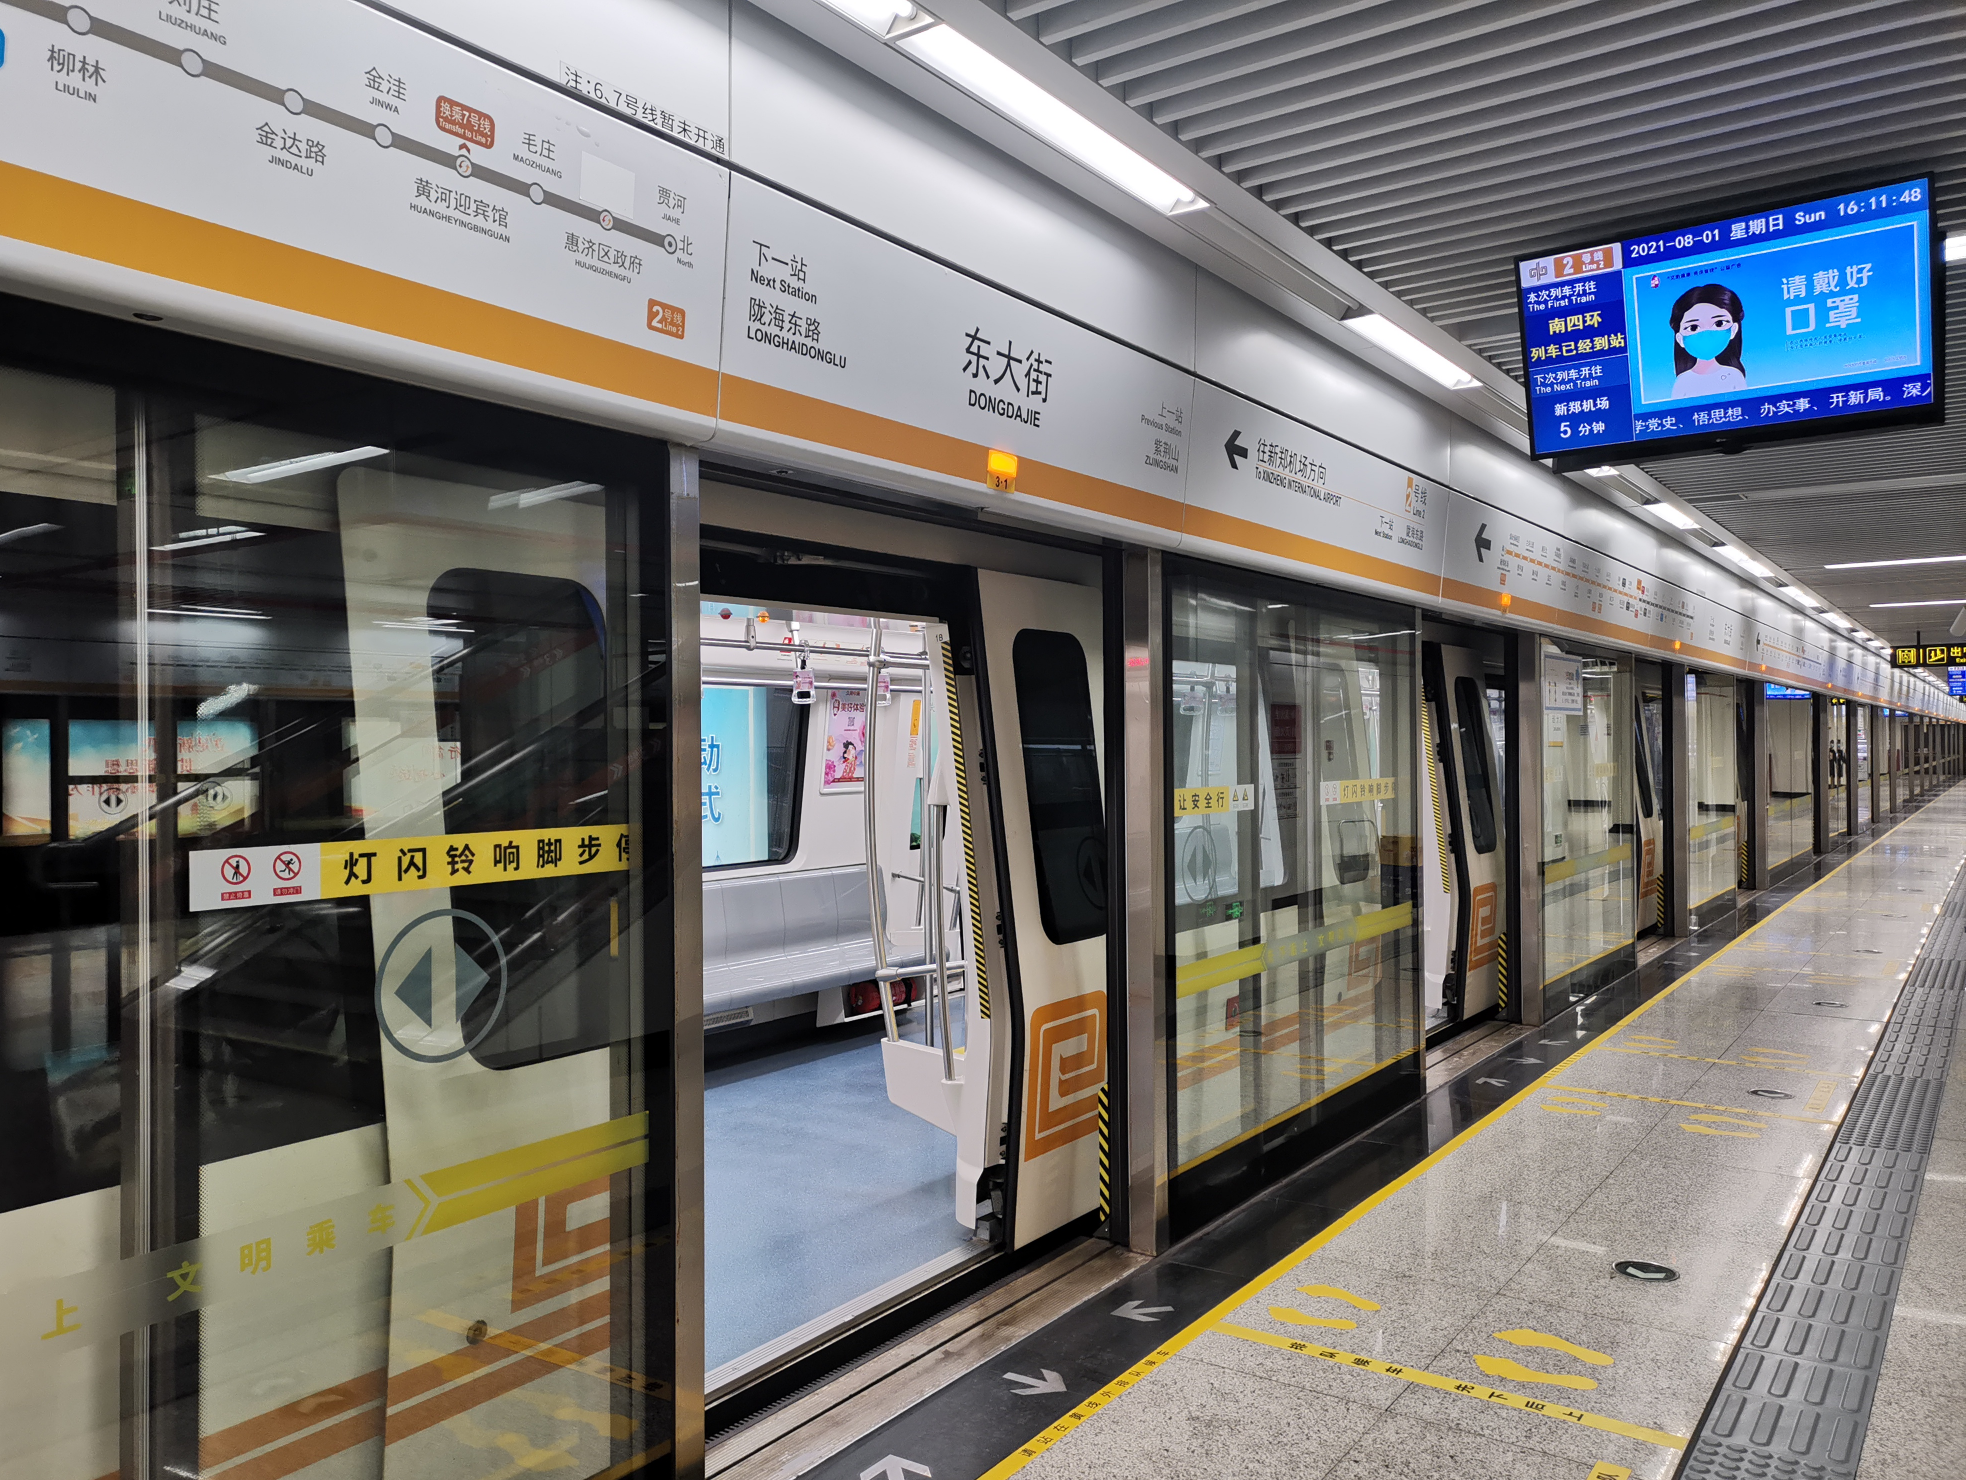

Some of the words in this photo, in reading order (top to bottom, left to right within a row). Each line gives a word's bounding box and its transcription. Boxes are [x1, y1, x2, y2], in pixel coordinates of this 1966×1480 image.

[158, 10, 227, 46] LIUZHUANG
[47, 44, 107, 87] 柳林
[55, 81, 97, 103] LIULIN
[364, 66, 407, 102] 金洼
[369, 96, 400, 116] JINWA
[440, 100, 491, 135] 换乘7号线
[255, 122, 327, 165] 金达路
[439, 118, 465, 135] Transfer
[465, 129, 472, 138] to
[473, 131, 486, 144] Line
[487, 137, 491, 146] 7
[522, 131, 556, 162] 毛庄
[268, 155, 314, 177] JINDALU
[512, 153, 563, 179] MAOZHUANG
[414, 177, 510, 229] 黄河迎宾馆
[657, 185, 687, 215] 贾河
[409, 202, 511, 244] HUANGHEYINGBINGUAN
[661, 213, 682, 227] JIAHE
[1630, 229, 1720, 258] 2021-08-01
[1730, 214, 1784, 241] 星期日
[1795, 210, 1825, 225] Sun
[1837, 188, 1922, 217] 16:11:48
[564, 231, 643, 276] 惠济区政府
[679, 235, 694, 257] 北
[676, 256, 694, 270] North
[752, 239, 808, 284] 下一站
[1582, 264, 1597, 272] Line
[750, 267, 776, 290] Next
[779, 279, 817, 304] Station
[1527, 281, 1597, 303] 本次列车开往
[1781, 263, 1873, 300] 请戴好
[1528, 302, 1545, 312] The
[1548, 298, 1568, 309] First
[1571, 293, 1595, 304] Train
[1784, 294, 1862, 336] 口罩
[662, 321, 677, 332] Line
[678, 326, 683, 335] 2
[748, 296, 821, 344] 陇海东路
[1548, 311, 1602, 336] 南四环
[747, 325, 847, 369] LONGHAIDONGLU
[1530, 332, 1625, 362] 列车已经到站
[962, 326, 1053, 404] 东大街
[1533, 365, 1603, 385] 下次列车开往
[1535, 386, 1551, 395] The
[1554, 382, 1574, 392] Next
[1576, 378, 1599, 389] Train
[968, 388, 1041, 428] DONGDAJIE
[1158, 401, 1183, 425] 上一站
[1554, 396, 1610, 416] 新郑机场
[1141, 414, 1163, 431] Previous
[1165, 423, 1182, 437] Station
[1560, 422, 1572, 438] 5
[1578, 421, 1606, 436] 分钟
[1145, 454, 1179, 474] ZIJINGSHAN
[1153, 438, 1180, 463] 紫荆山
[1257, 437, 1327, 485] 往新郑机场方向
[1255, 466, 1262, 480] To
[1262, 469, 1287, 488] XINZHENG
[1287, 478, 1322, 501] INTERNATIONAL
[1323, 491, 1342, 507] AIRPORT
[1950, 646, 1966, 657] 出
[1179, 792, 1225, 811] 让安全行
[166, 1203, 396, 1302] 文明乘车
[40, 1298, 82, 1341] 上
